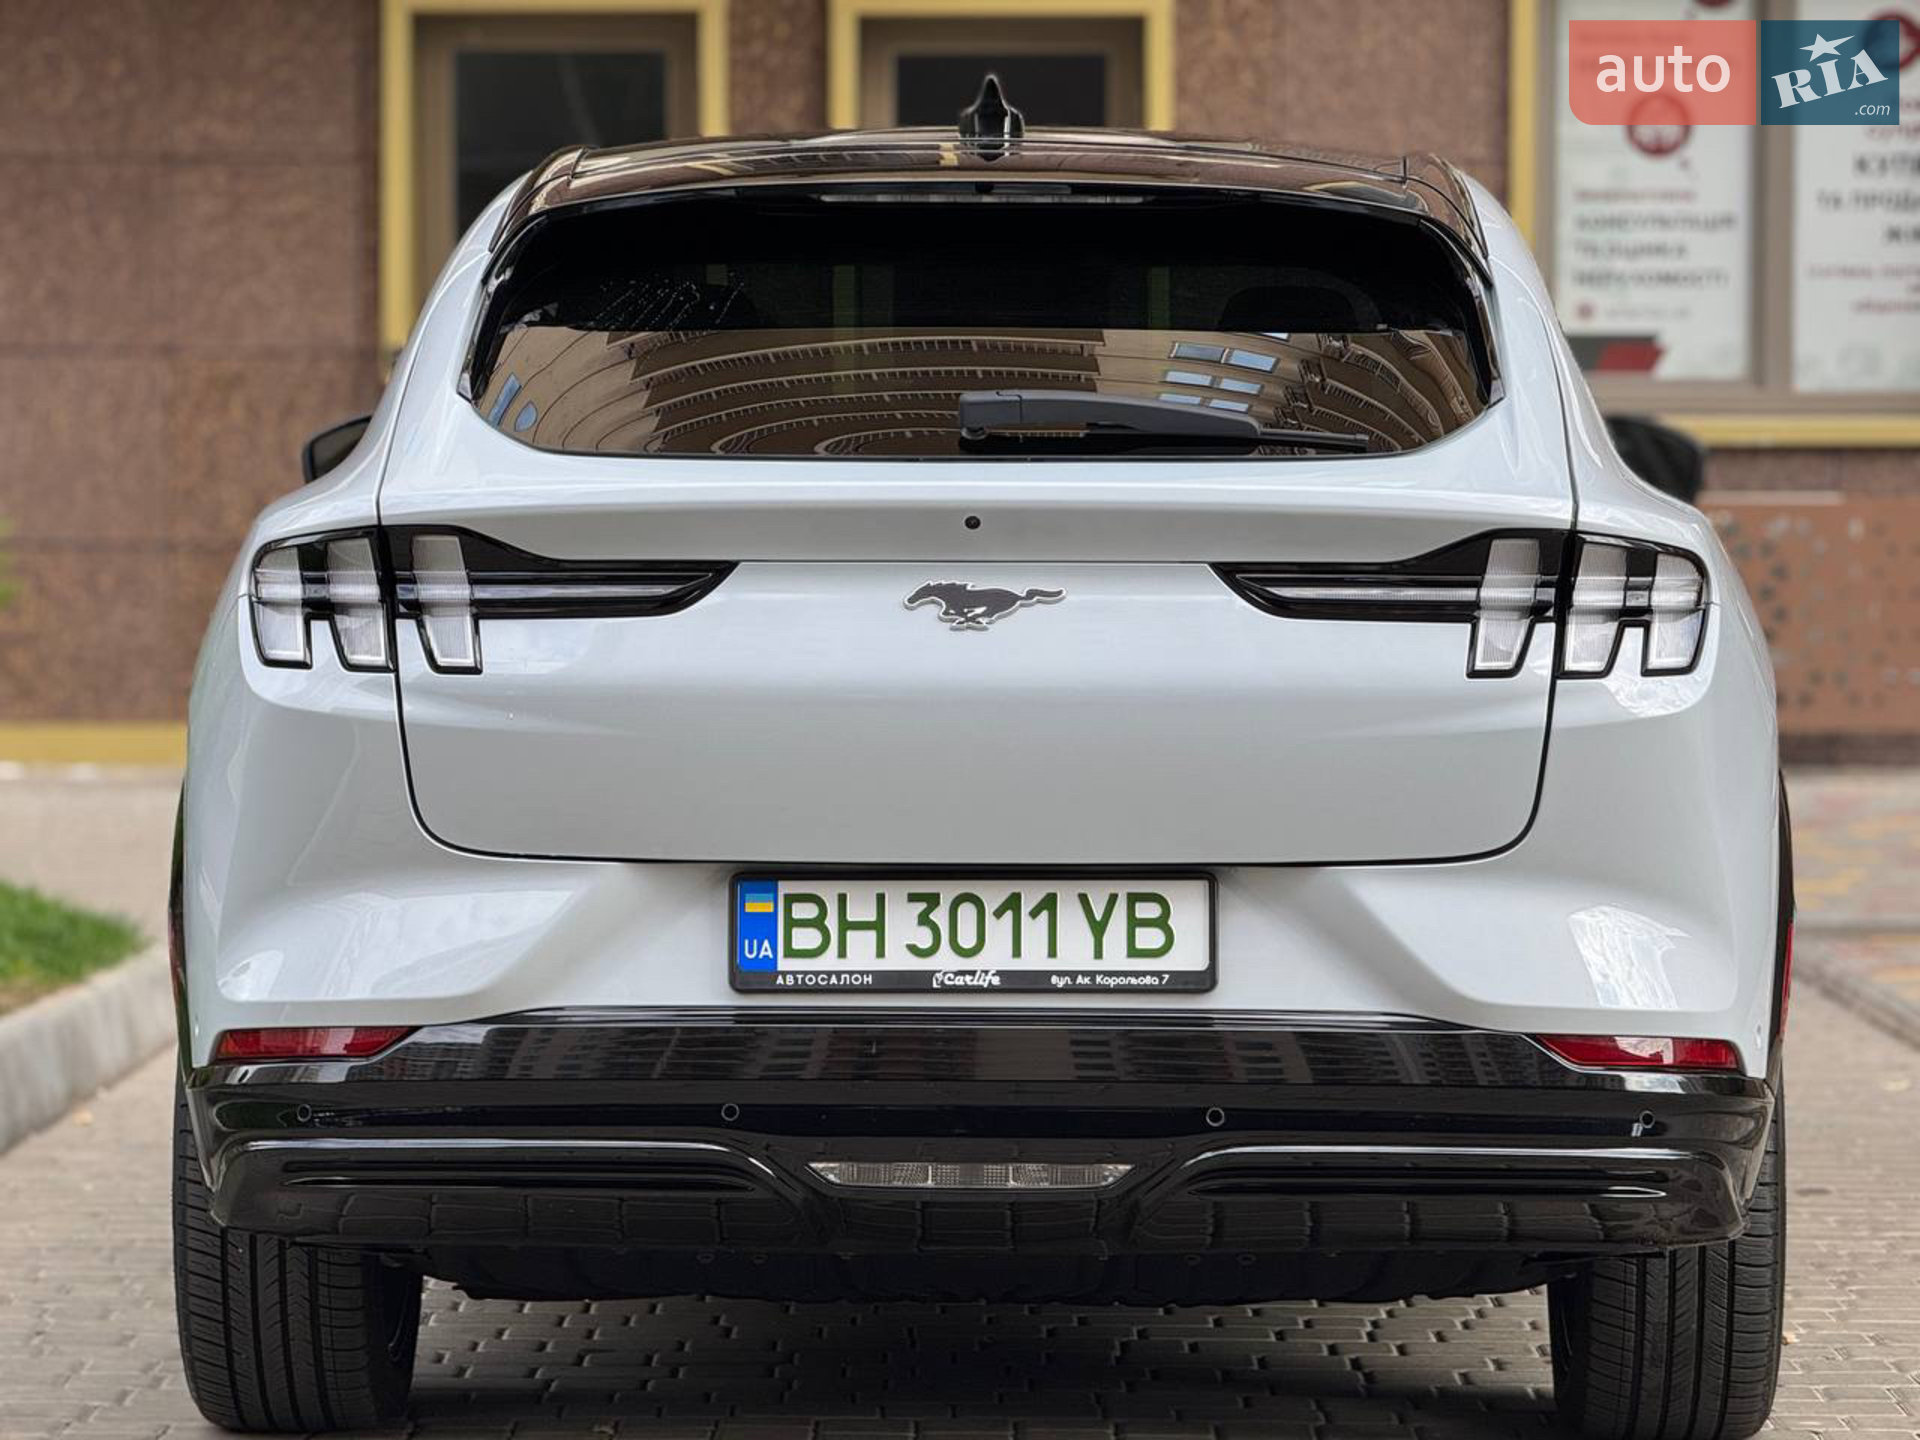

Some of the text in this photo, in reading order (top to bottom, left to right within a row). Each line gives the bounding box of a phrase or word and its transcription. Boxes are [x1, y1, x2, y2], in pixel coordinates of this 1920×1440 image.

[783, 892, 1175, 960] BH 3011 YB
[744, 938, 774, 959] UA
[776, 974, 873, 985] АВТОСАЛОН
[1161, 974, 1170, 985] 7
